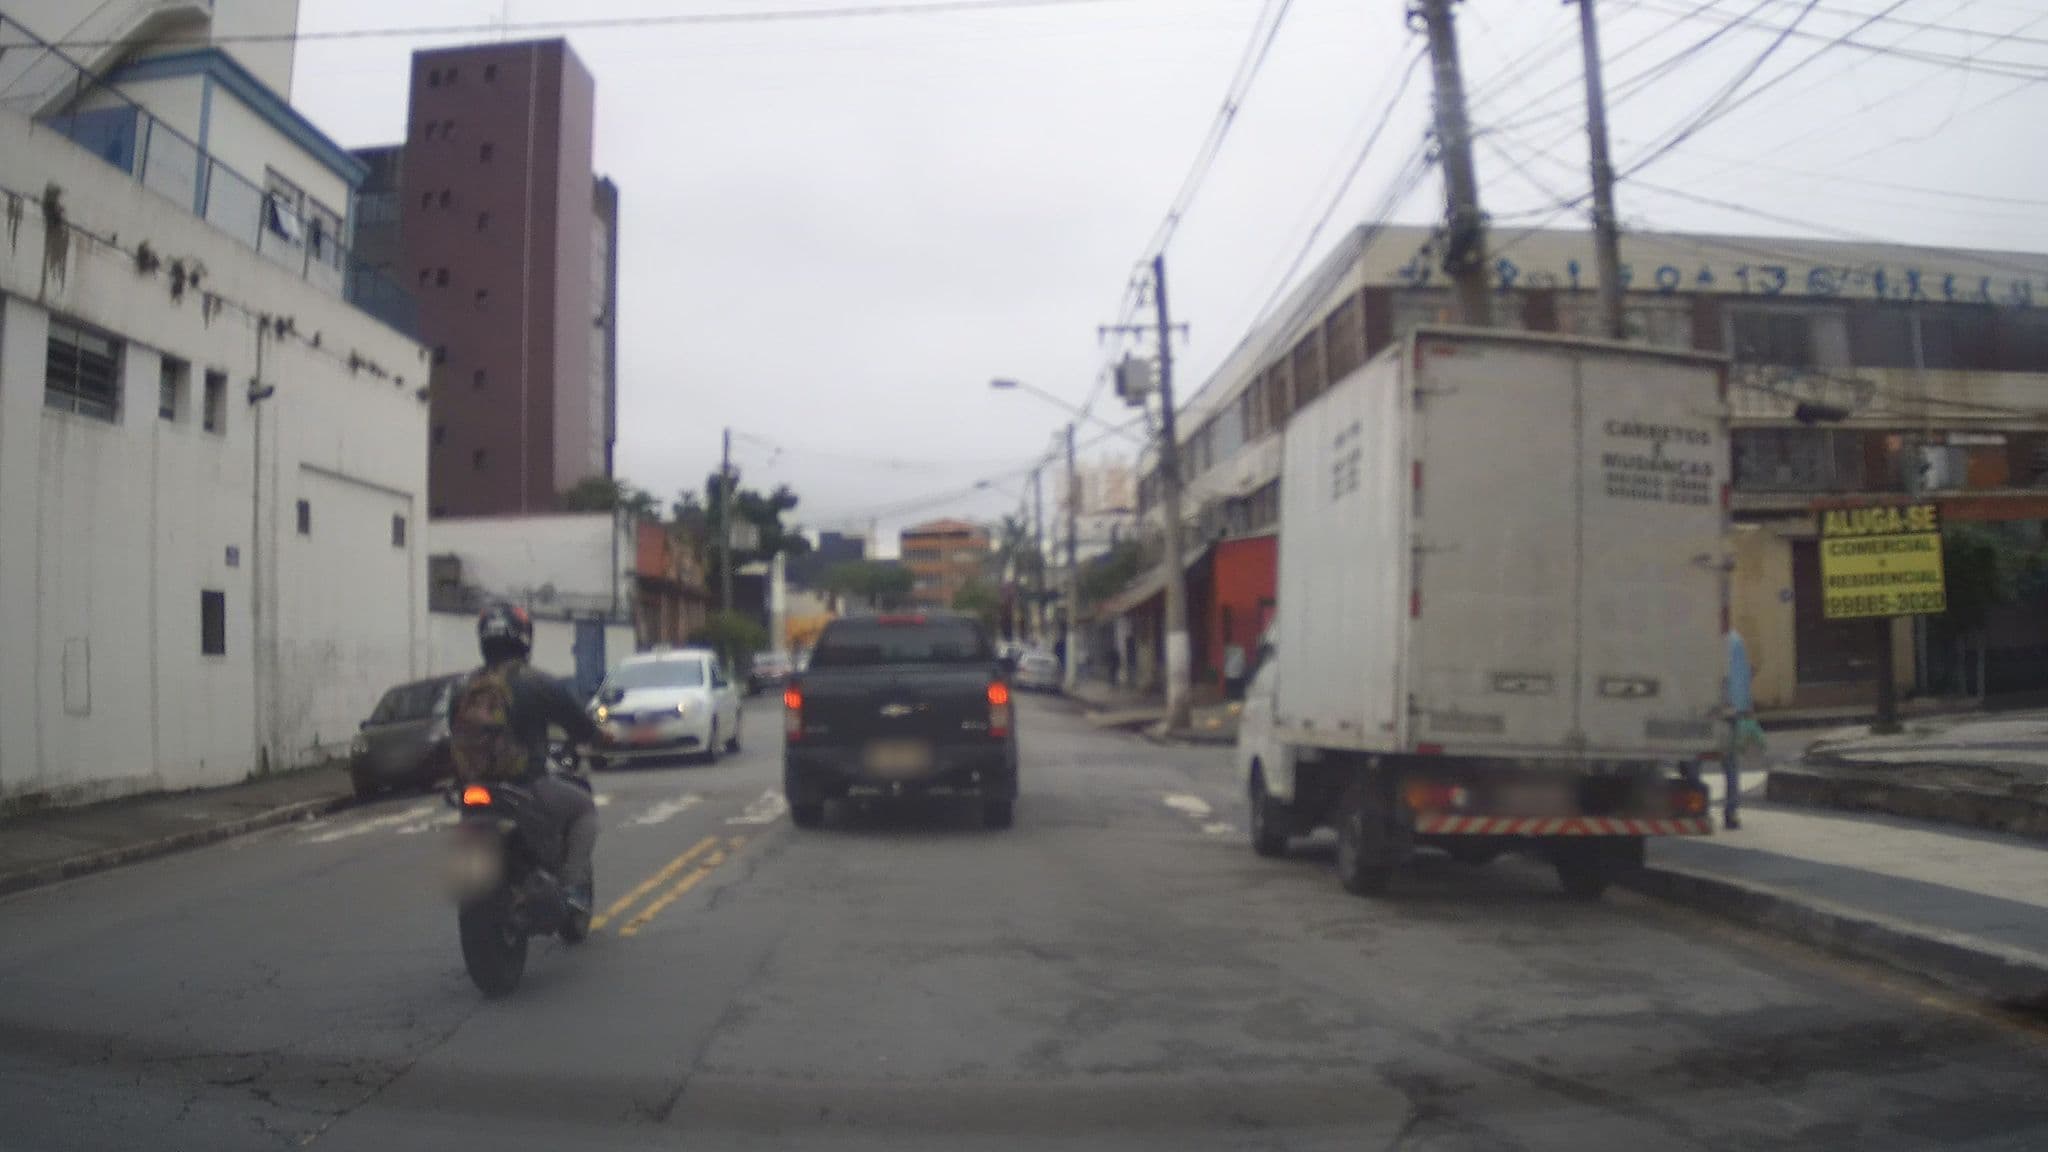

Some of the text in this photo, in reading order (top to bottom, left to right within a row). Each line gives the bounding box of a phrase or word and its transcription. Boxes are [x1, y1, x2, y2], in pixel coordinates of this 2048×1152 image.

[1604, 419, 1711, 446] CARRETOS
[1825, 506, 1937, 534] ALUGA-SE
[1829, 539, 1936, 556] COMERCIAL
[1828, 571, 1939, 588] RESIDENCIAL
